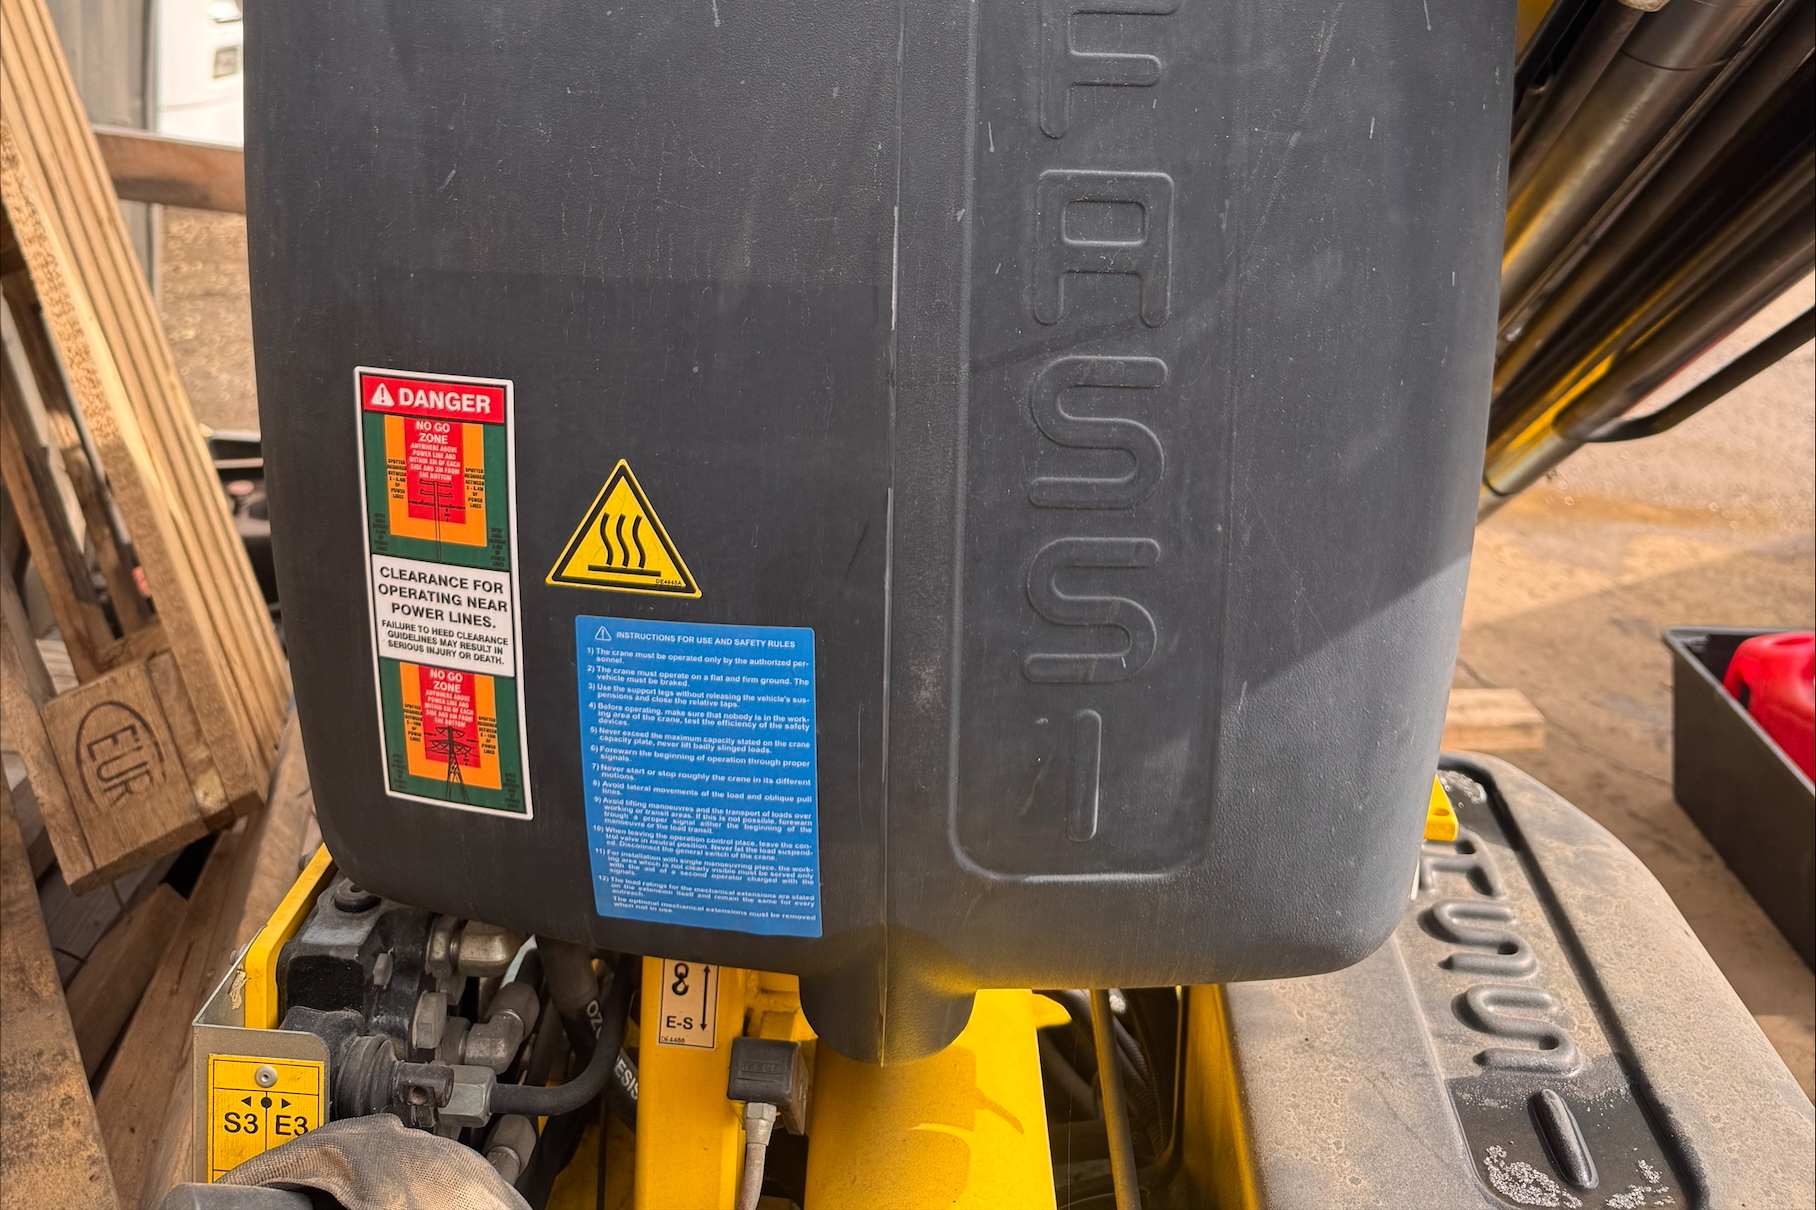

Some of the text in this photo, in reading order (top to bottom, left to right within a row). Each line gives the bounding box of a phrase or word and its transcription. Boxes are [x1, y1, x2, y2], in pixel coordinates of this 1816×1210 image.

[399, 388, 491, 414] DANGER
[416, 421, 450, 433] NO GO
[419, 433, 448, 444] ZONE
[411, 443, 457, 453] ANYWHERE ABOVE
[413, 449, 432, 457] POWER
[432, 451, 444, 459] LINE
[430, 472, 452, 480] BOTTOM
[380, 566, 504, 594] CLEARANCE FOR
[378, 583, 508, 612] OPERATING NEAR
[391, 602, 496, 628] POWER LINES.
[382, 619, 508, 645] FAILURE TO HEED CLEARANCE
[616, 631, 795, 648] INSTRUCTIONS FOR USE AND SAFETY RULES
[388, 630, 438, 645] GUIDELINES
[440, 638, 458, 648] MAY
[460, 641, 491, 653] RESULT
[388, 640, 504, 665] SERIOUS INJURY OR DEATH.
[587, 647, 594, 655] 1)
[596, 647, 610, 655] The
[635, 650, 654, 659] must
[656, 652, 666, 660] be
[668, 653, 702, 663] operated
[704, 655, 721, 664] only
[723, 656, 732, 665] by
[749, 657, 791, 666] authorized
[793, 660, 808, 668] per-
[596, 655, 624, 664] sonnel.
[430, 669, 463, 683] NO GO
[587, 664, 594, 673] 2)
[597, 665, 611, 673] The
[637, 668, 657, 677] must
[659, 670, 689, 680] operate
[725, 674, 740, 682] and
[742, 675, 758, 683] firm
[760, 676, 791, 686] ground.
[597, 673, 624, 683] vehicle
[626, 676, 646, 684] must
[659, 679, 690, 688] braked.
[433, 681, 461, 693] ZONE
[426, 689, 470, 702] ANYWHERE ABOVE
[427, 696, 446, 704] POWER
[425, 703, 443, 711] WITHIN
[460, 708, 474, 716] EACH
[426, 709, 437, 717] SIDE
[458, 714, 473, 722] FROM
[445, 719, 466, 728] BOTTOM
[87, 724, 154, 807] EUR
[1419, 824, 1600, 1189] ASSI
[587, 1000, 603, 1039] OZ
[666, 1015, 693, 1030] E-S
[614, 1055, 638, 1100] ESIS
[224, 1112, 309, 1137] S3 E3
